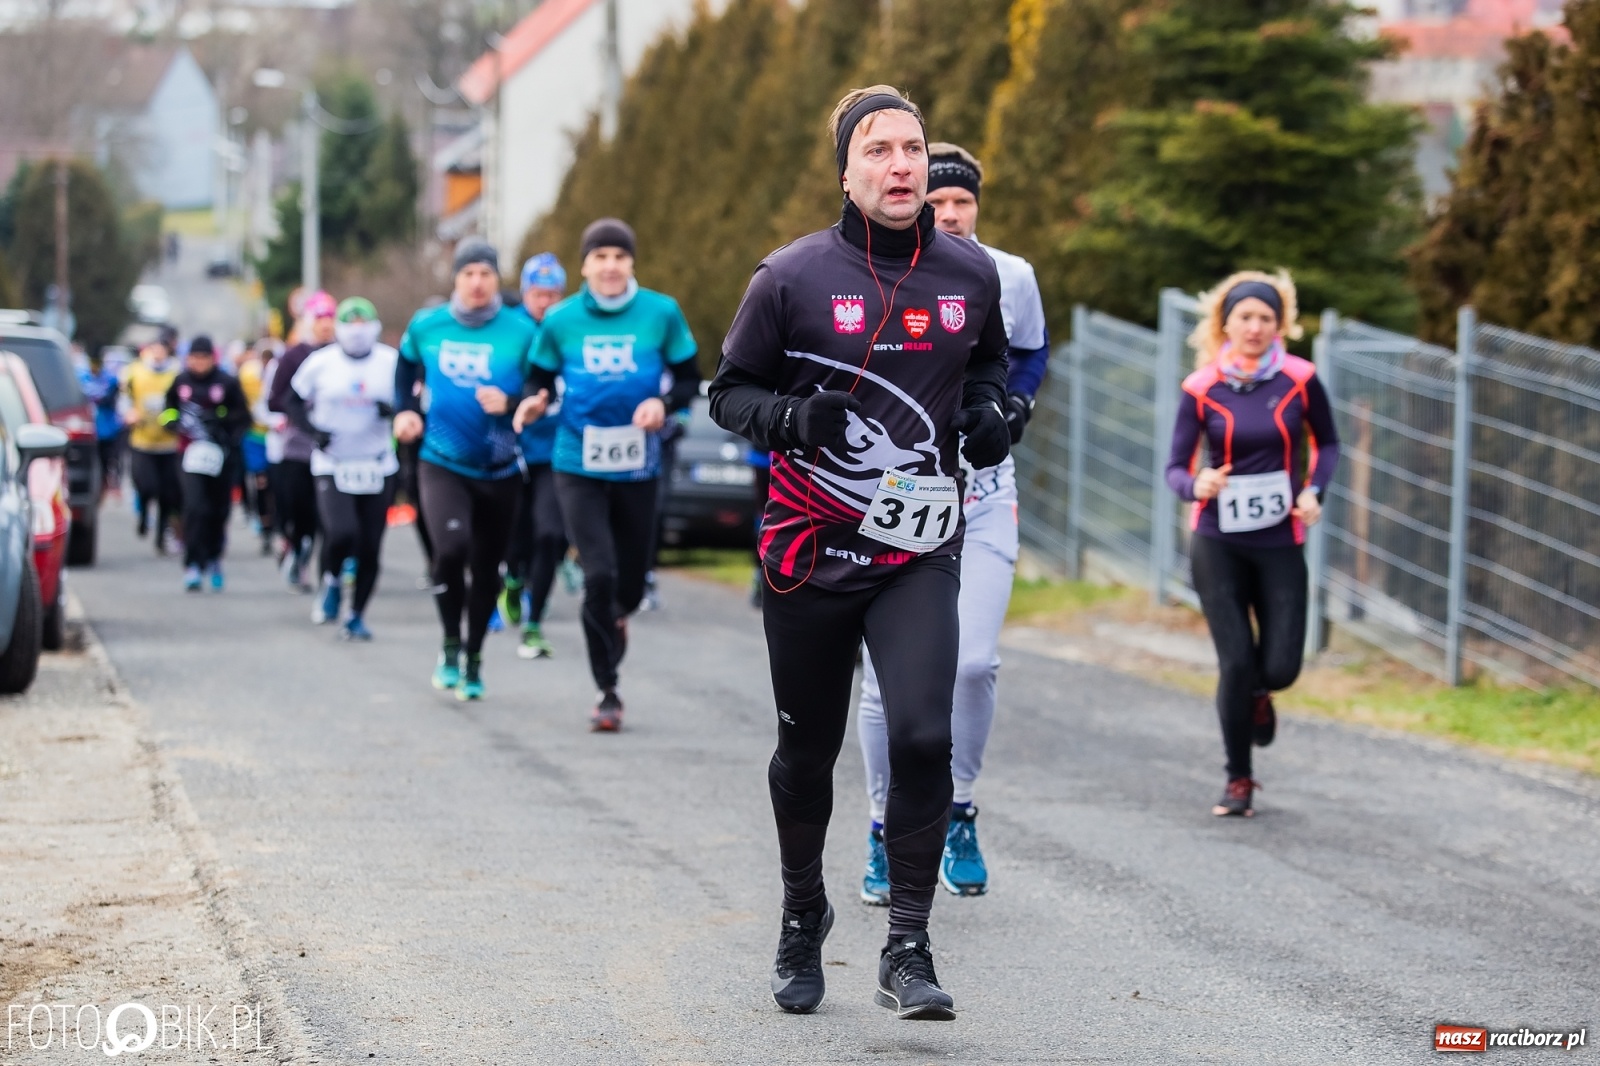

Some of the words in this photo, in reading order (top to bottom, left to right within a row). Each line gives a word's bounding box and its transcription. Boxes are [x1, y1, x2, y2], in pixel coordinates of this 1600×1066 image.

[590, 441, 640, 463] 266
[873, 497, 952, 539] 311
[1227, 494, 1285, 519] 153
